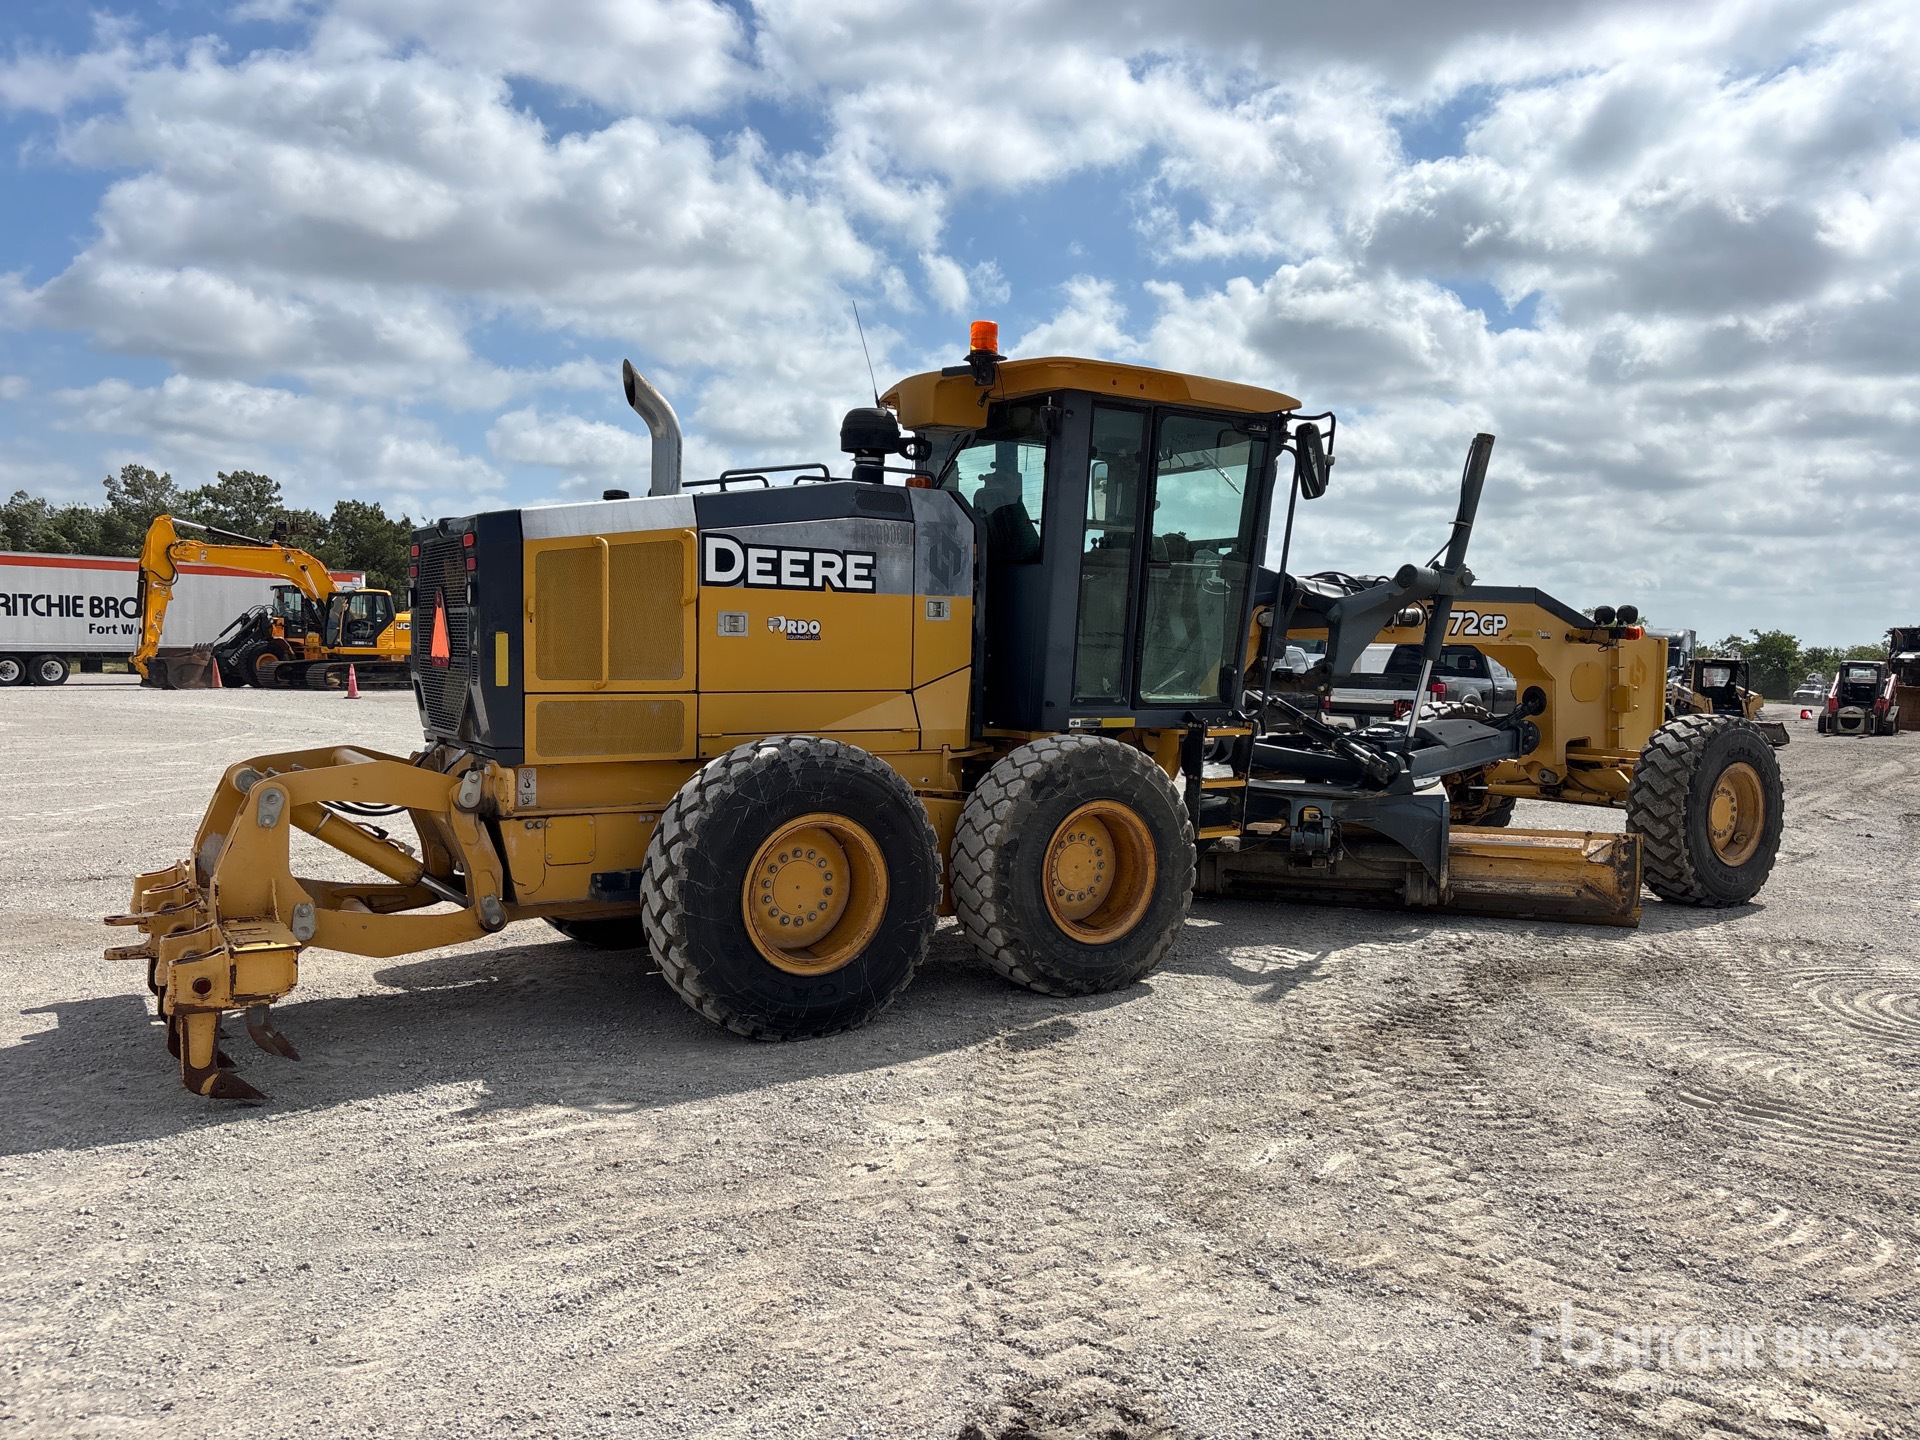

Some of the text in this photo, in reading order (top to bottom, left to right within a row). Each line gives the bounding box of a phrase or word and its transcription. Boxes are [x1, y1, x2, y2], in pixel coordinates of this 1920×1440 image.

[702, 534, 875, 592] DEERE
[0, 593, 84, 617] RITCHIE
[88, 623, 118, 635] Fort
[786, 619, 821, 635] RDO
[1448, 610, 1507, 636] 72GP
